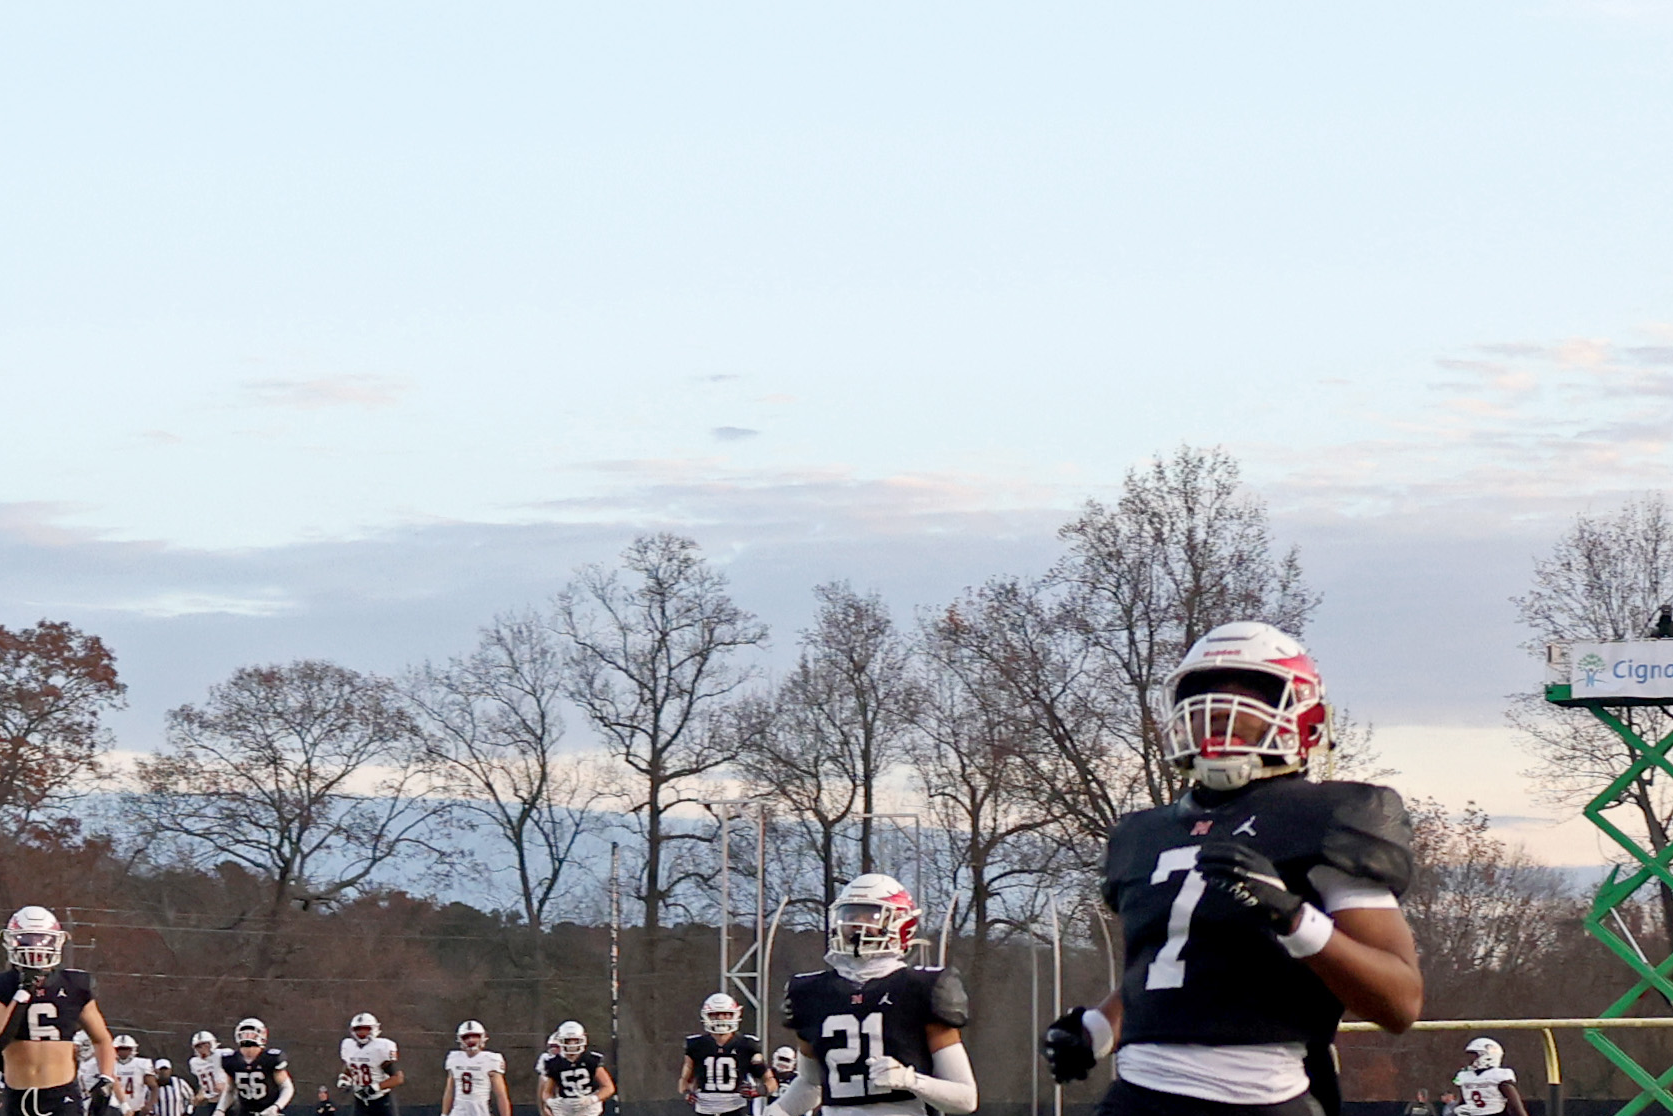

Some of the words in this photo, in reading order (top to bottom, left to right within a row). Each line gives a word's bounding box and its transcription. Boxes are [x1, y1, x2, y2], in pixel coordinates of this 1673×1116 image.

[1145, 845, 1207, 990] 7
[28, 1003, 61, 1040] 6
[821, 1012, 893, 1098] 21
[235, 1072, 267, 1100] 56
[461, 1072, 472, 1095] 6
[560, 1068, 592, 1097] 52
[704, 1056, 738, 1091] 10
